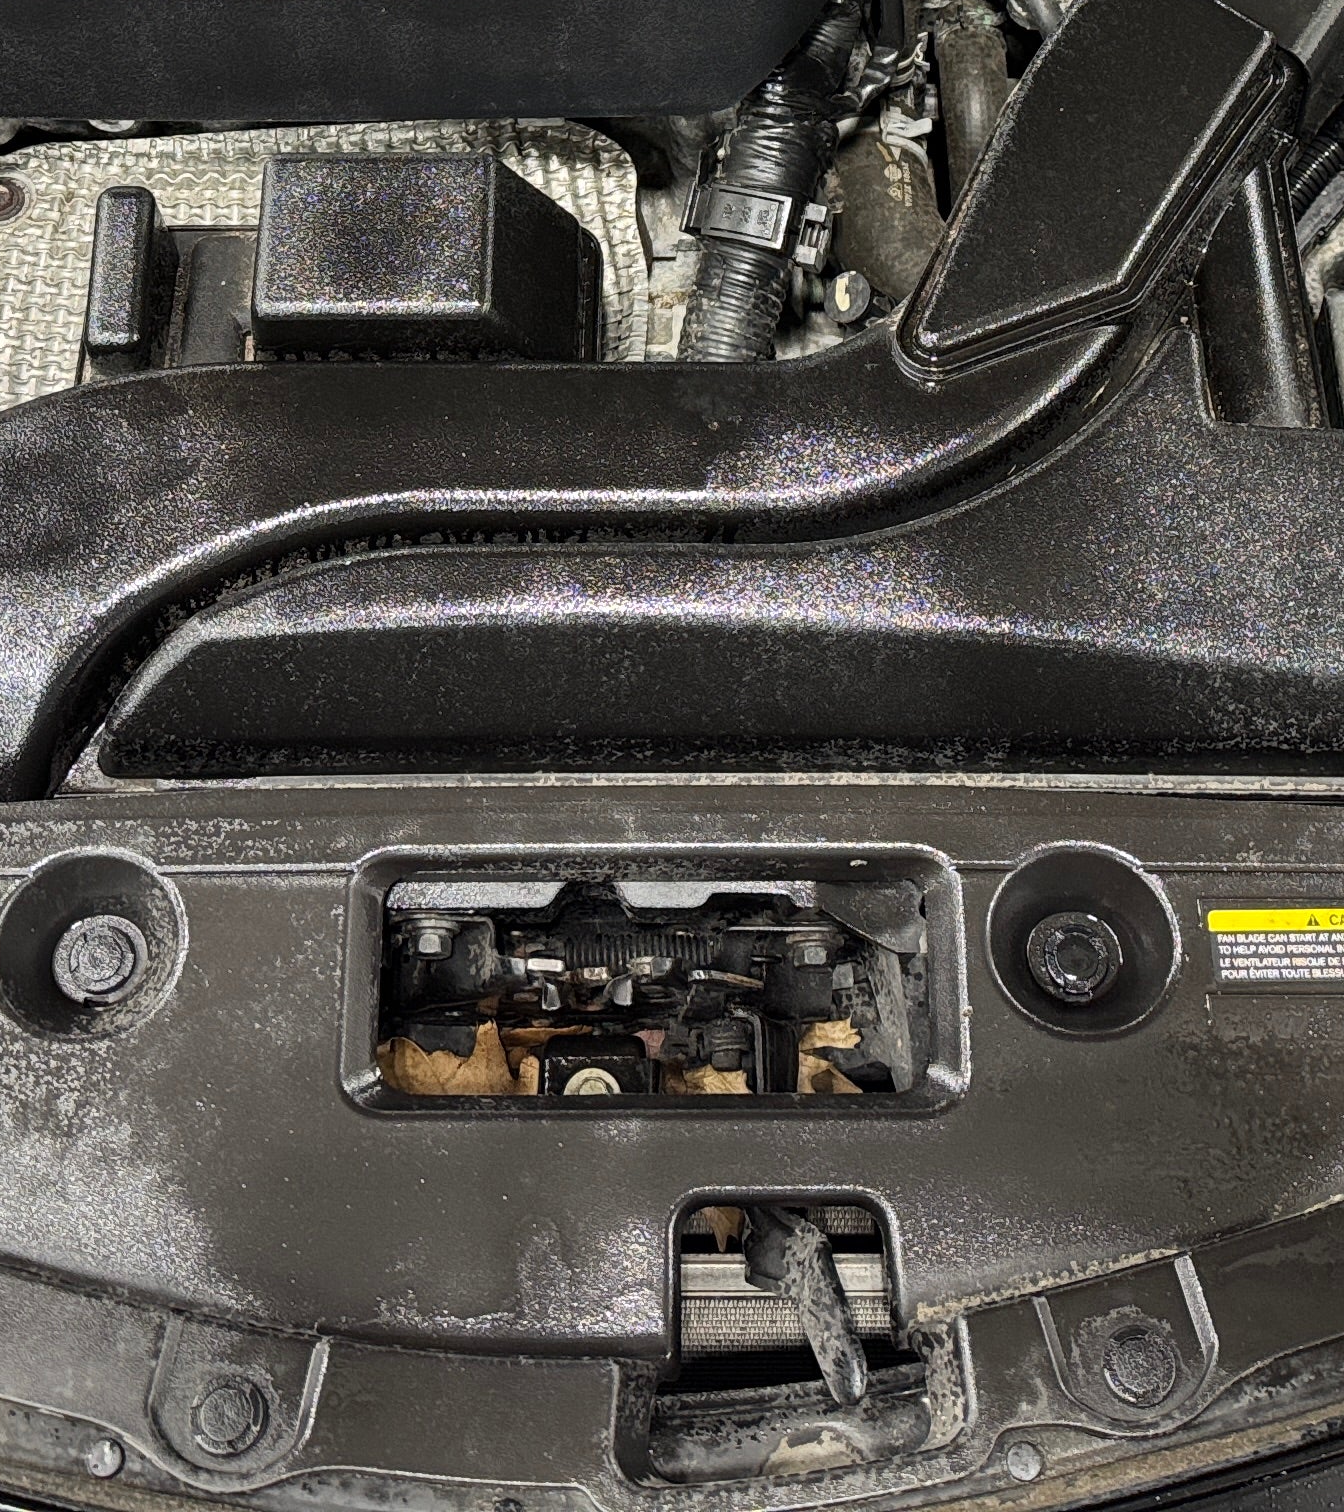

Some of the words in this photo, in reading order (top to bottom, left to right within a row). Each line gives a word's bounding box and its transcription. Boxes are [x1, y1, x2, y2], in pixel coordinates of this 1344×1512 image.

[1217, 933, 1236, 943] FAN
[1236, 933, 1266, 943] BLADE
[1267, 933, 1287, 942] CAN
[1288, 933, 1318, 942] START
[1319, 933, 1329, 942] AT
[1218, 945, 1231, 955] TO
[1233, 945, 1256, 955] HELP
[1258, 945, 1285, 955] AVOID
[1287, 945, 1335, 954] PERSONAL
[1220, 958, 1232, 967] LE
[1233, 957, 1291, 967] VENTILATEUR
[1292, 957, 1326, 967] RISQUE
[1327, 957, 1341, 966] DE
[1221, 969, 1248, 979] POUR
[1281, 969, 1310, 978] TOUTE
